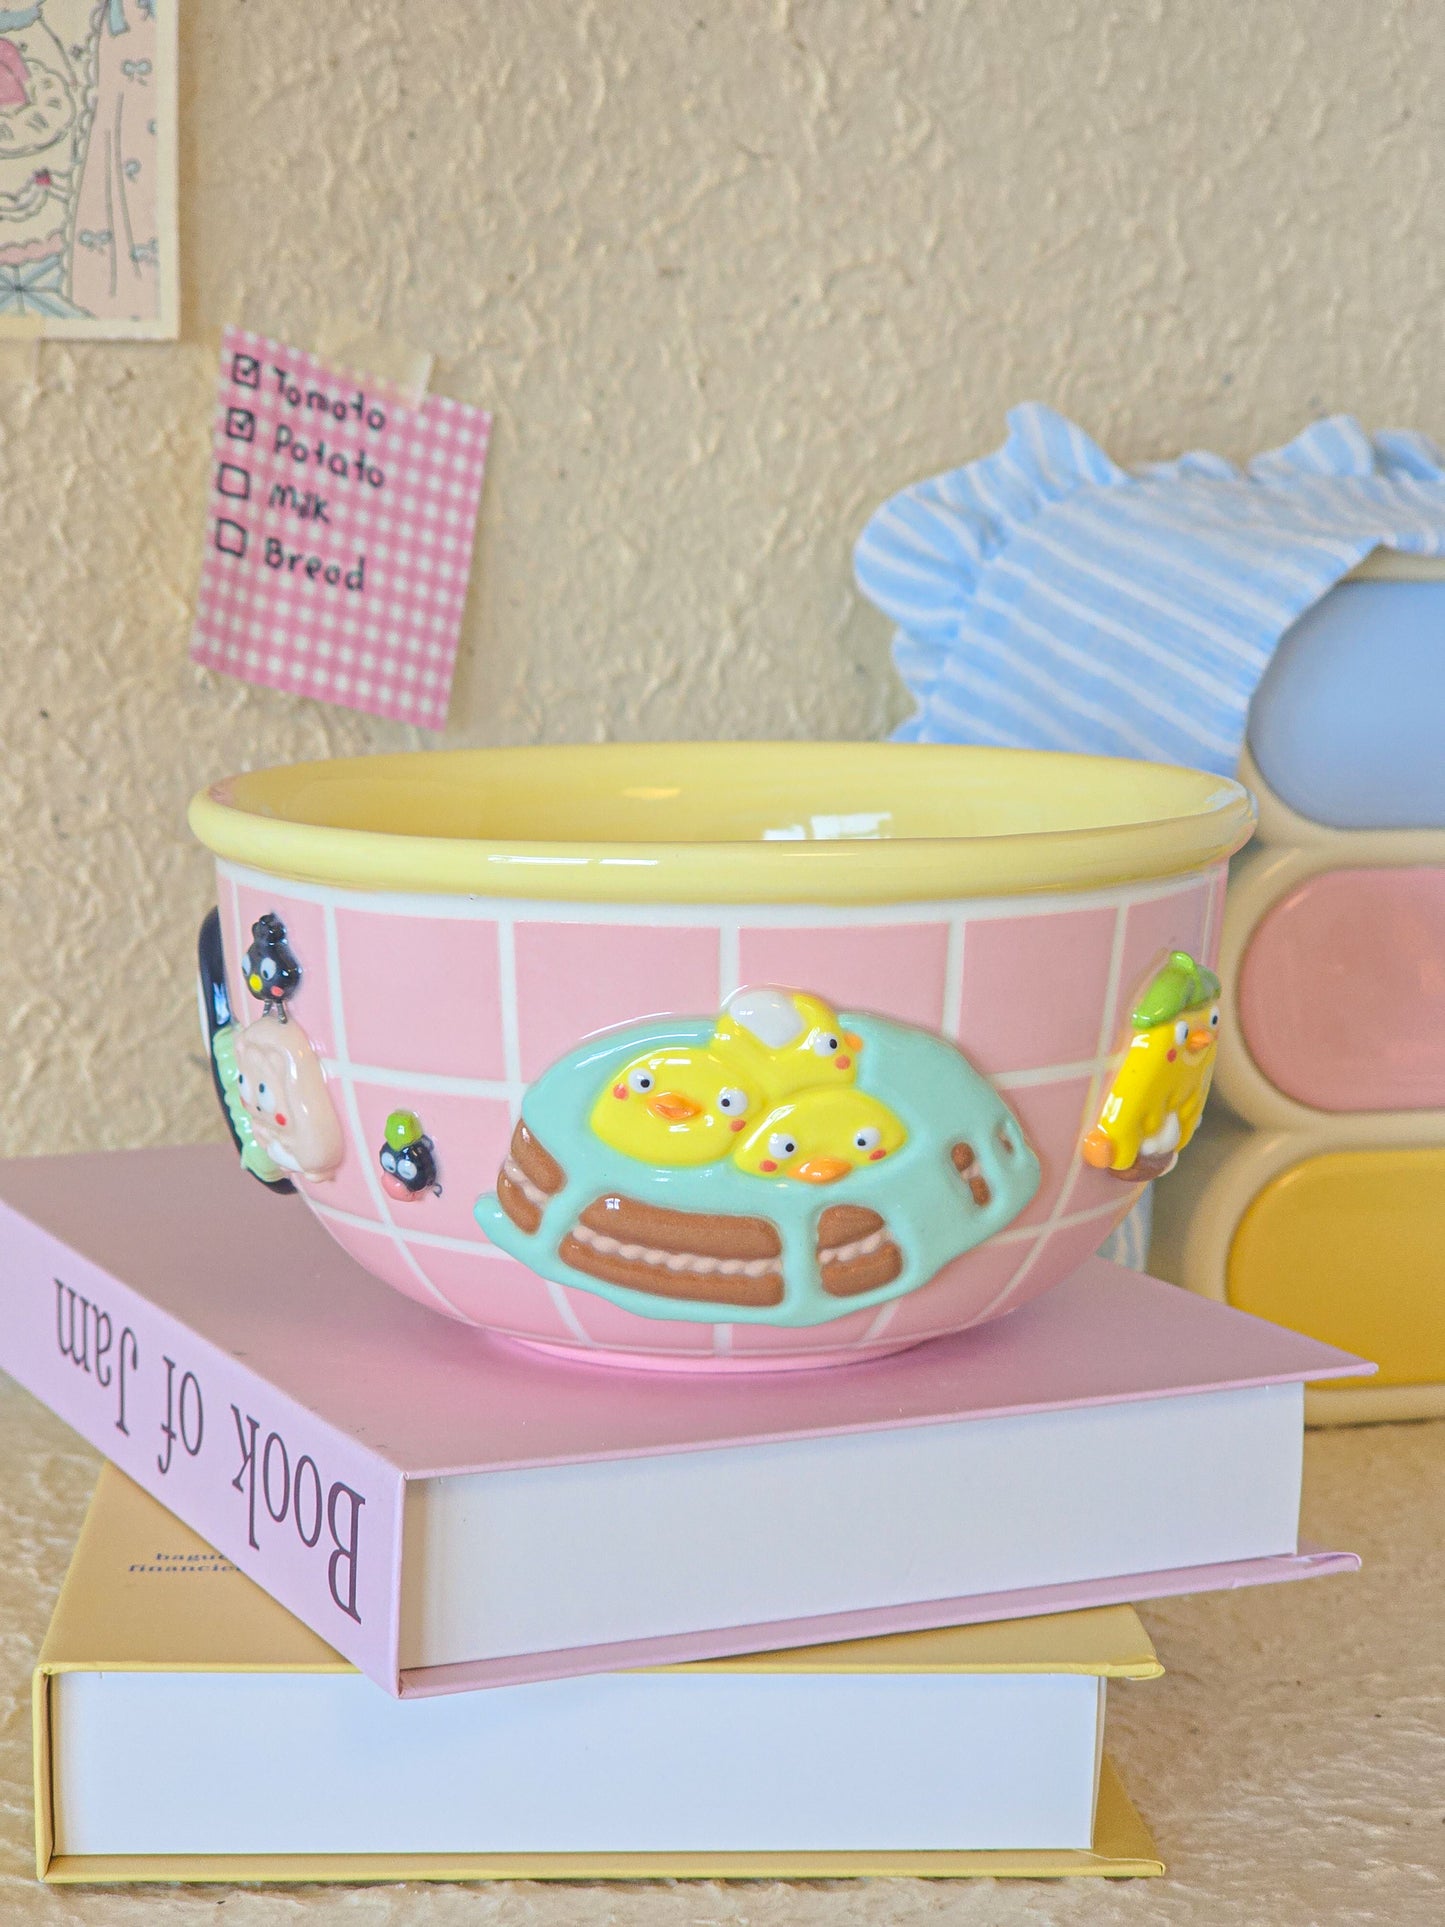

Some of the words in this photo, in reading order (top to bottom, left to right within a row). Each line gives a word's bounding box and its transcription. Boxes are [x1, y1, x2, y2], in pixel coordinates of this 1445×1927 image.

[274, 367, 386, 430] Tomato
[274, 424, 385, 487] Potato
[269, 483, 330, 523] Milk
[265, 537, 364, 591] Bread
[54, 1278, 137, 1436] Jam
[158, 1355, 203, 1474] of
[231, 1403, 366, 1624] Book
